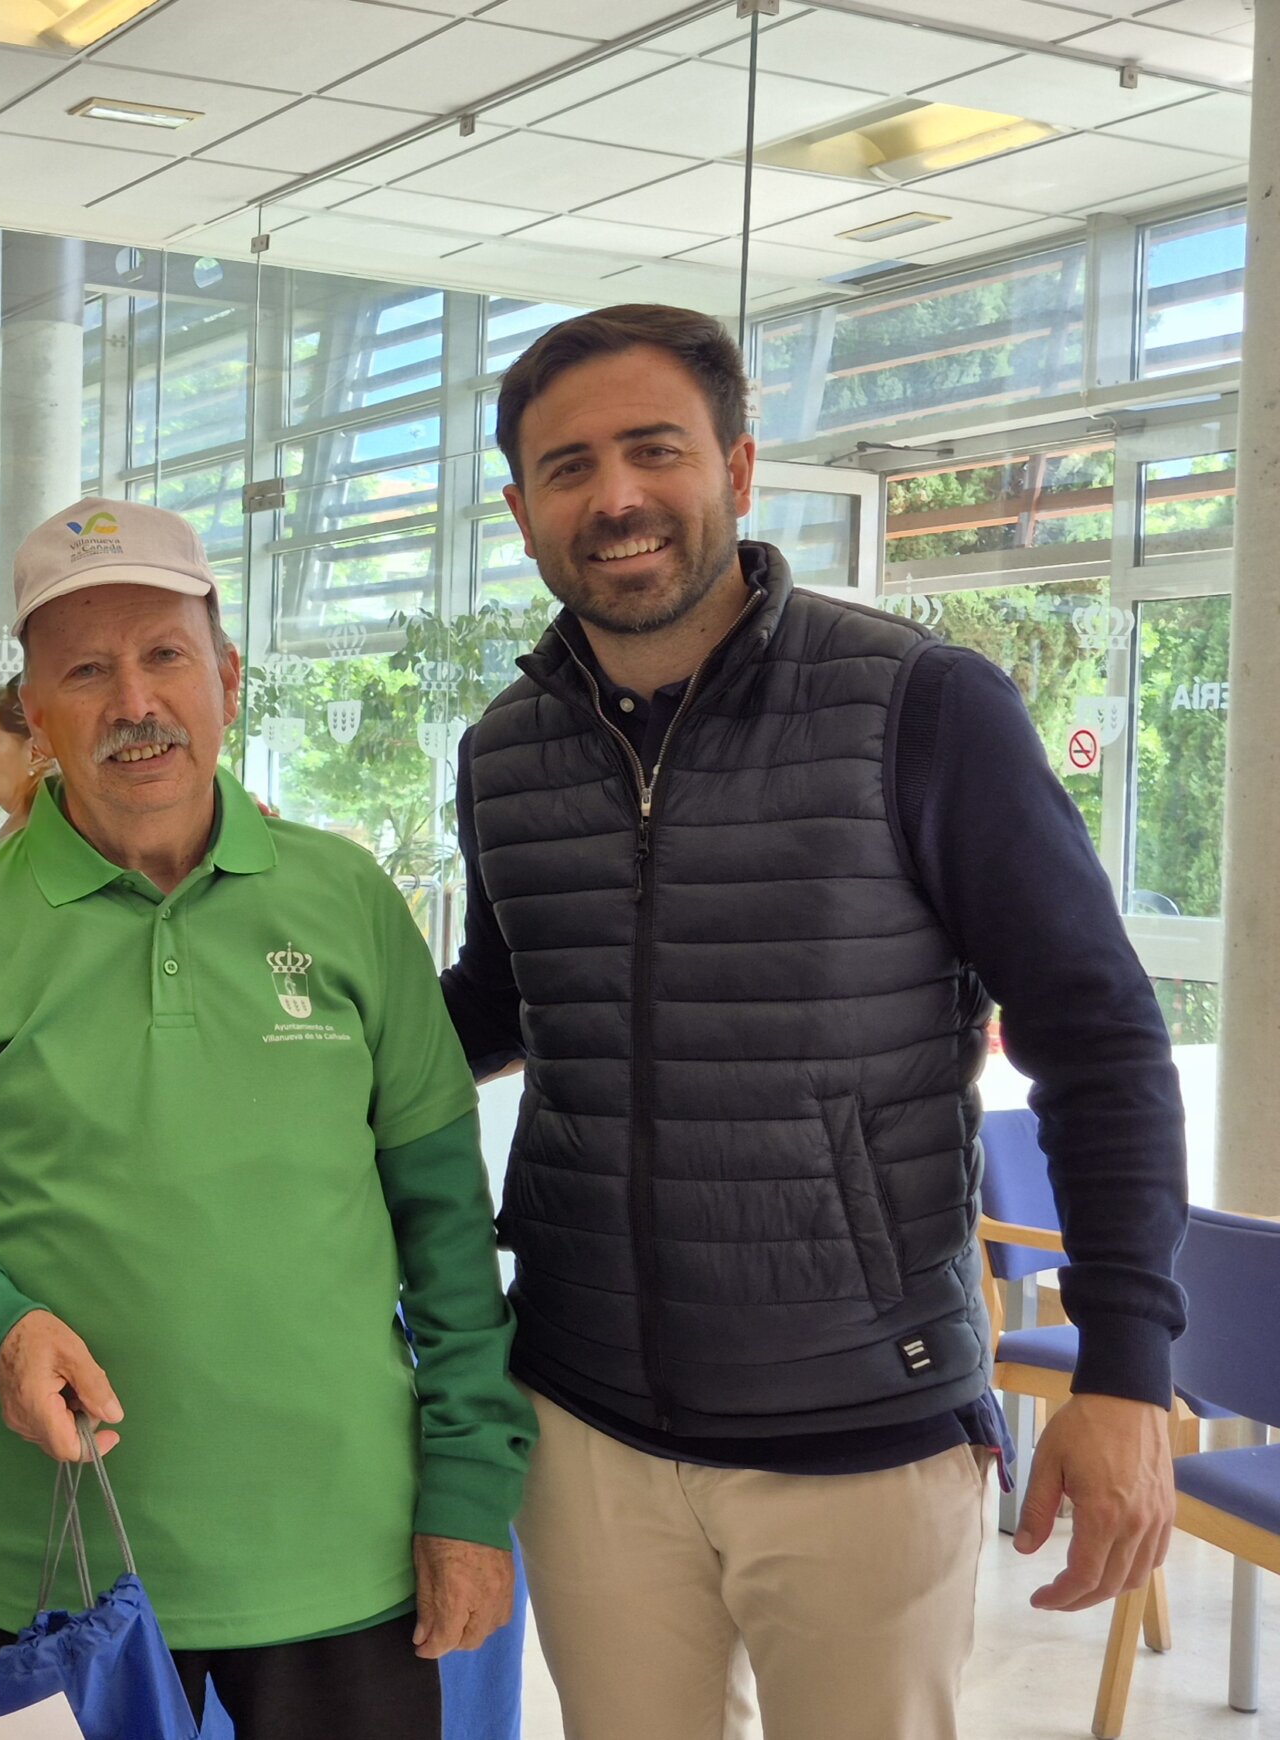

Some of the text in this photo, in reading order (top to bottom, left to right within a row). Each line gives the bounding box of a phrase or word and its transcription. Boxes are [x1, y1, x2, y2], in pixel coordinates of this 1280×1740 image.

[70, 538, 121, 551] Villanueva
[274, 1023, 324, 1032] Ayuntamiento
[262, 1033, 303, 1043] Villanueva
